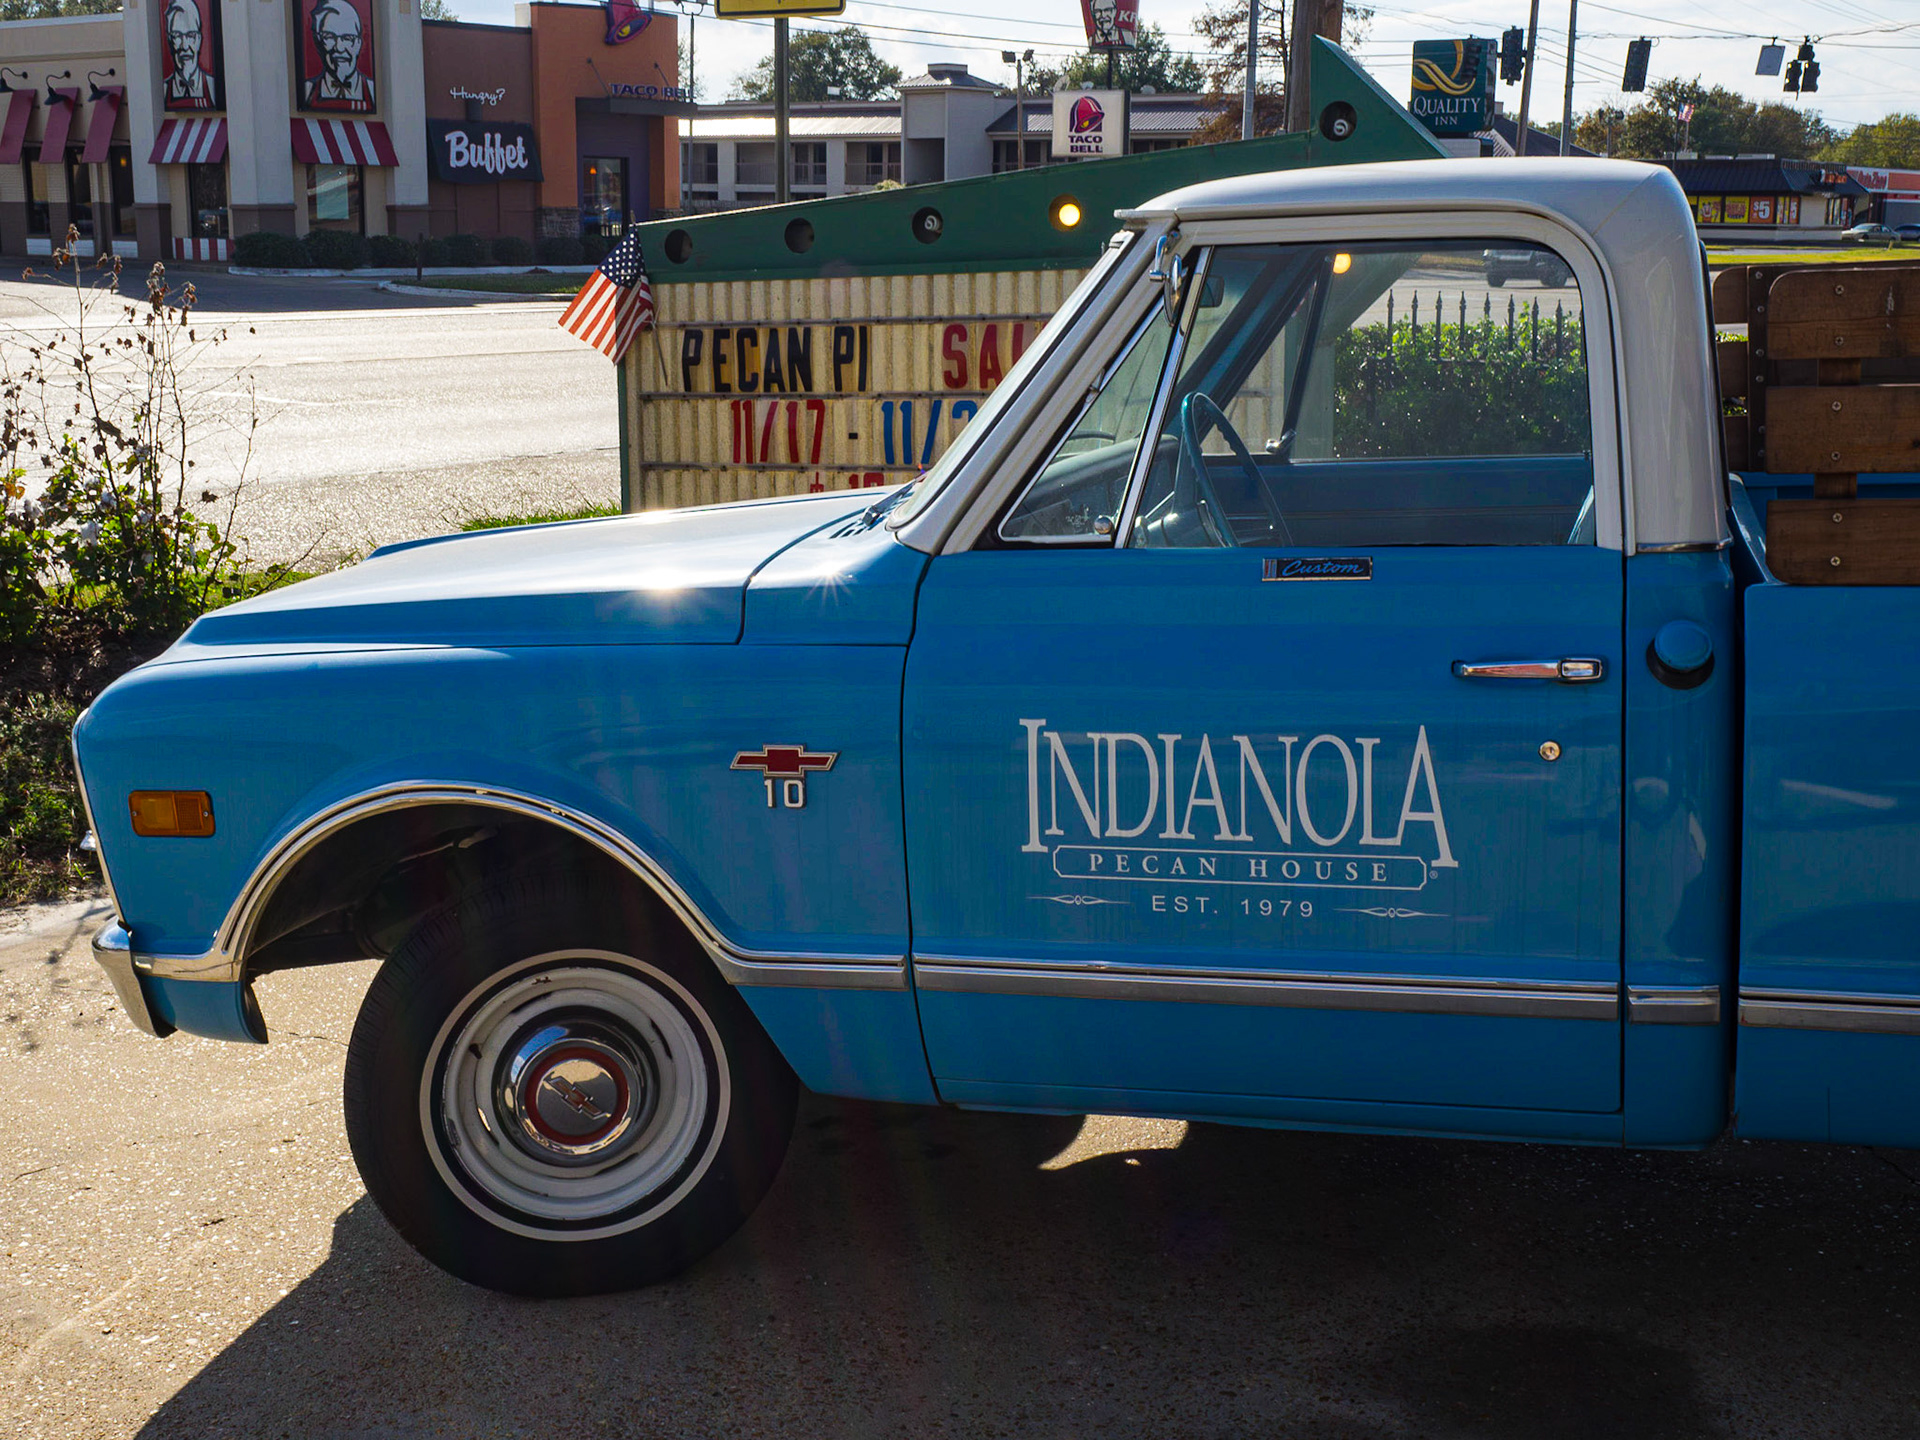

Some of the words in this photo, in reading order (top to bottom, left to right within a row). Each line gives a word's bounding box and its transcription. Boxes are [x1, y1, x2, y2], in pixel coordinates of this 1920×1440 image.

[450, 86, 506, 106] Hungry?
[609, 82, 658, 97] TACO
[662, 86, 697, 99] BELL
[1413, 95, 1481, 117] QUALITY
[1435, 116, 1458, 126] INN
[1068, 135, 1103, 144] TACO
[1070, 145, 1103, 153] BELL
[445, 130, 529, 174] Buffet
[681, 326, 813, 393] PECAN
[833, 325, 868, 392] PI
[942, 323, 1047, 390] SAL
[731, 400, 825, 464] 11/17
[1282, 560, 1364, 576] Custom
[764, 779, 804, 808] 10
[1019, 718, 1459, 868] INDIANOLA
[1089, 853, 1218, 876] PECAN
[1249, 859, 1388, 882] HOUSE
[1152, 895, 1219, 914] EST.
[1240, 898, 1314, 918] 1979
